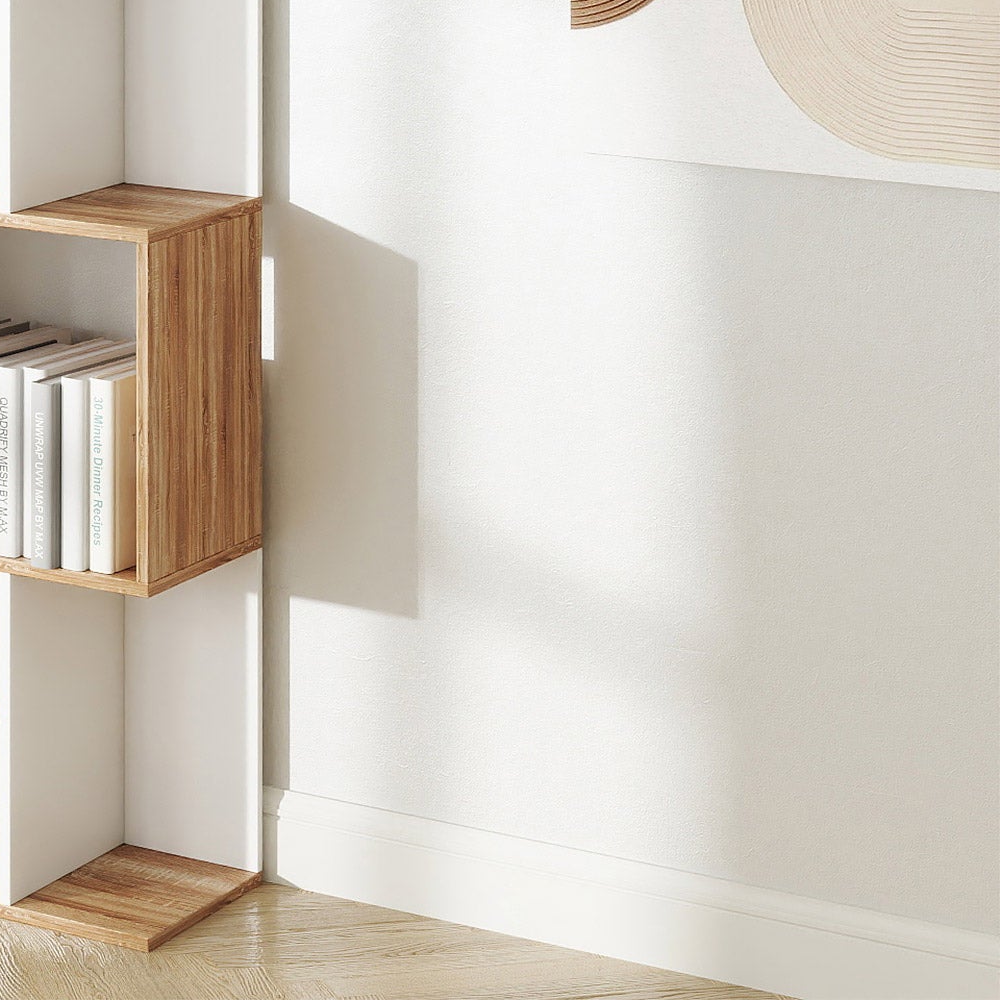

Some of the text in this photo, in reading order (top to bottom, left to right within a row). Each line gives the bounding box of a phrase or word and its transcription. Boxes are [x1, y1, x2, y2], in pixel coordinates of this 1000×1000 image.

[0, 397, 8, 454] QUADRIFY
[34, 412, 44, 460] UNWRAP
[0, 455, 8, 488] MESH
[34, 462, 44, 488] UVW
[92, 396, 103, 546] 30-Minute Dinner Recipes
[0, 489, 8, 505] BY
[34, 489, 44, 514] MAP
[34, 514, 44, 531] BY
